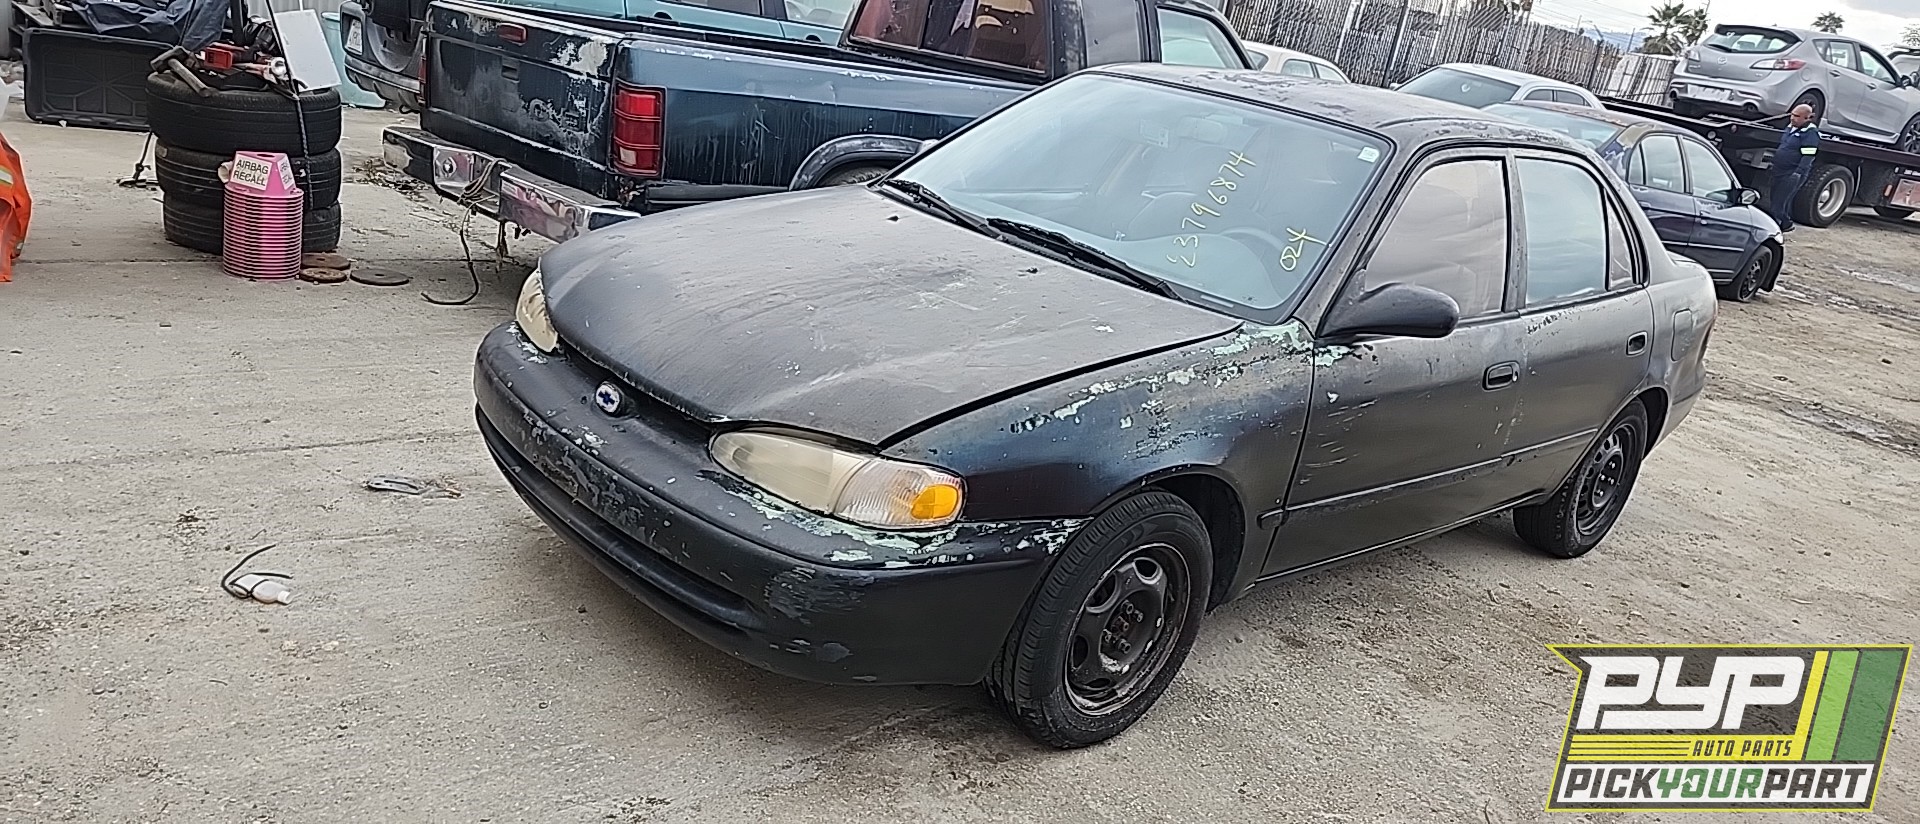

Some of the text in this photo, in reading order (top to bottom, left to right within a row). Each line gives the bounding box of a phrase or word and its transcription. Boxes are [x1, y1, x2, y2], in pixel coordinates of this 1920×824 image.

[236, 159, 269, 174] AIRBAG
[233, 170, 266, 186] RECALL
[1280, 227, 1332, 271] 024
